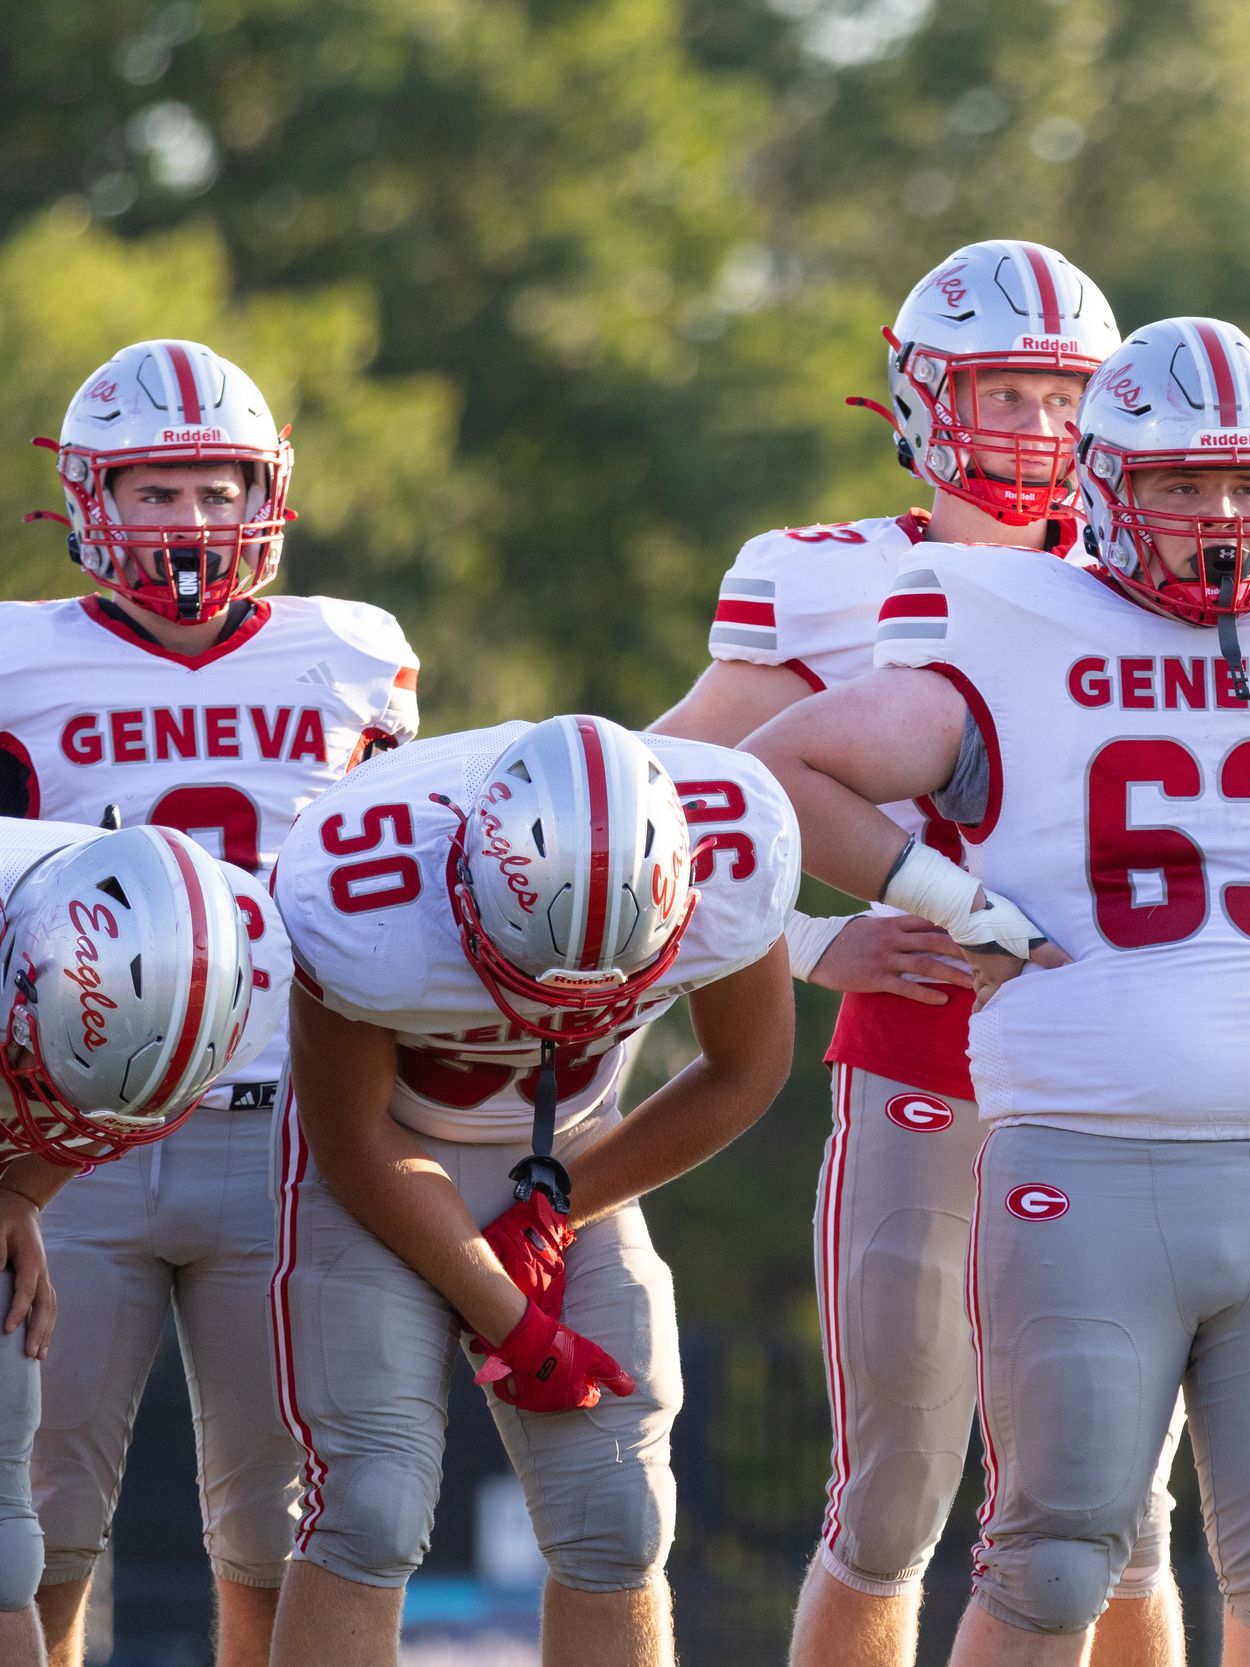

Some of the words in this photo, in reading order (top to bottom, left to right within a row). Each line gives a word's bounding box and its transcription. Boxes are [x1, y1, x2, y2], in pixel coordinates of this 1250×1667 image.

[1022, 337, 1078, 352] Riddell
[163, 429, 222, 442] Riddell
[1004, 490, 1036, 501] Ridell
[59, 704, 328, 766] GENEVA
[320, 801, 424, 916] 50
[63, 899, 120, 1053] Eagles
